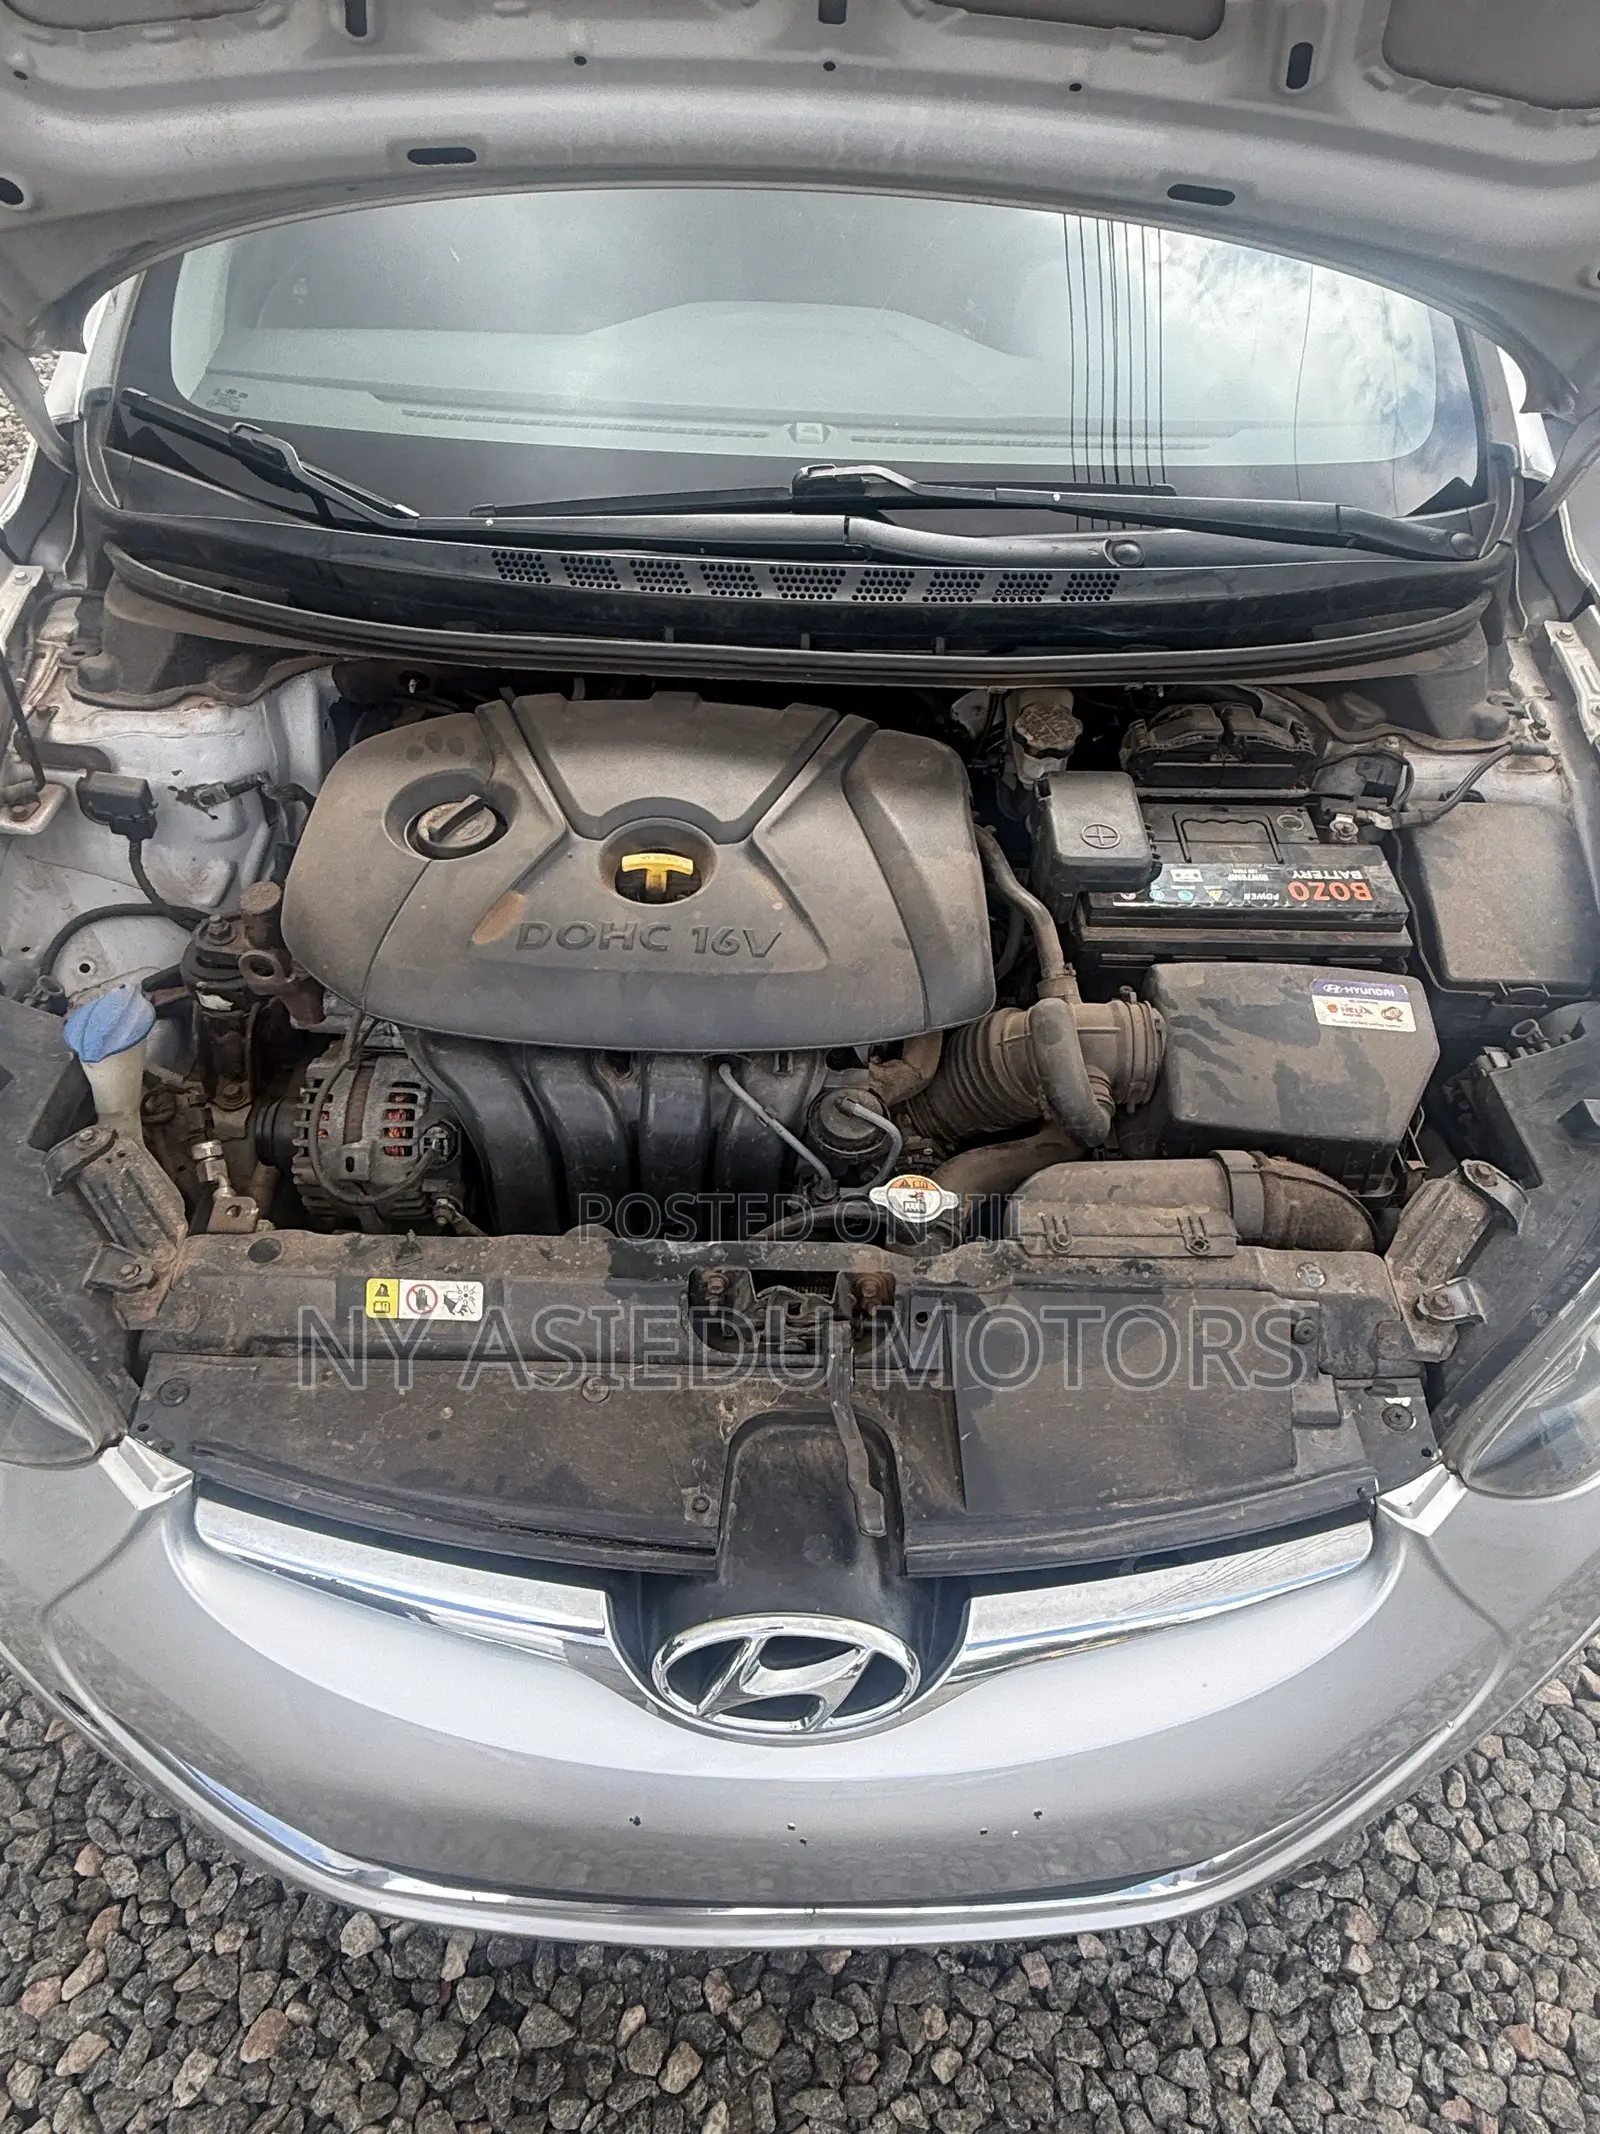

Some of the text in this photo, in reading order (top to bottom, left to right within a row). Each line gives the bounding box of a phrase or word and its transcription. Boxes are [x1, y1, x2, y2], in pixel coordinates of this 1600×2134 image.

[1292, 869, 1364, 880] BATTERY
[1288, 881, 1374, 901] BOZO
[515, 920, 781, 958] DOHC 16V
[1343, 986, 1395, 997] HYUNDAI
